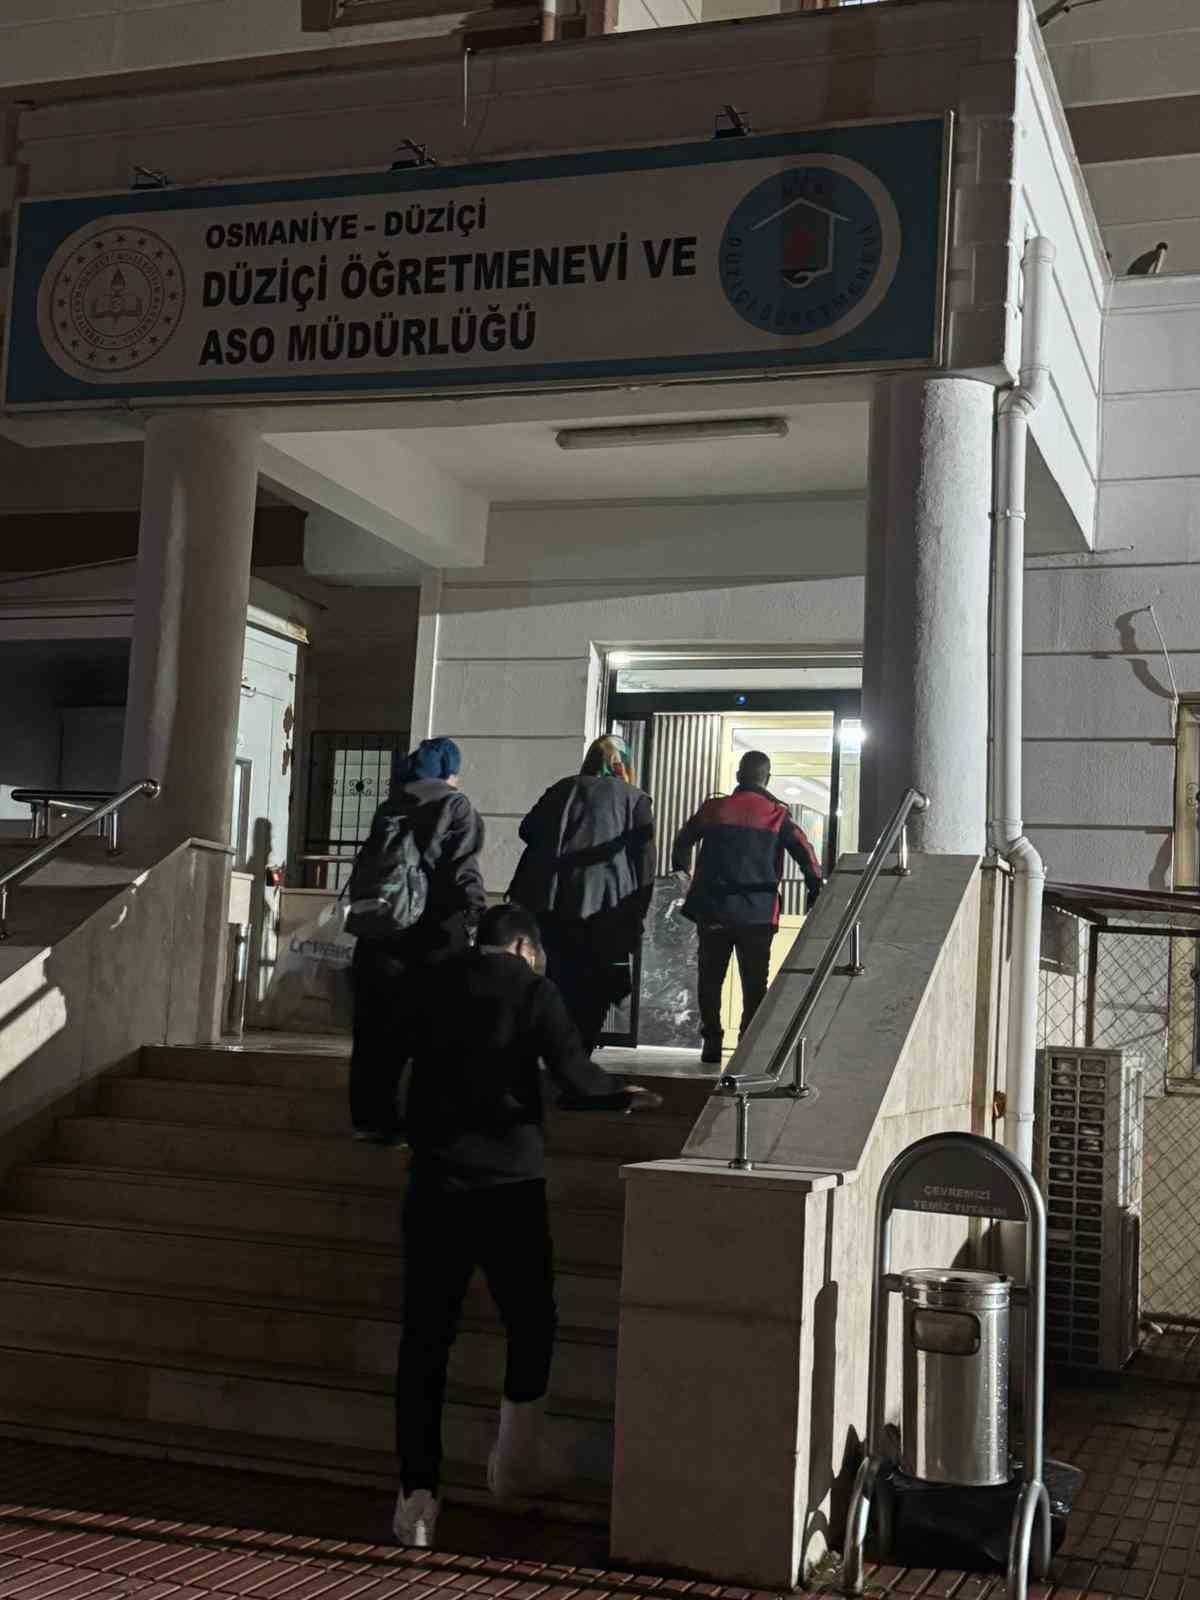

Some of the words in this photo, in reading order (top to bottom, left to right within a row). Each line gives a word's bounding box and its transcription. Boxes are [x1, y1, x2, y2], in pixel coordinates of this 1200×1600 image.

[206, 210, 358, 250] OSMANİYE
[384, 197, 487, 238] DÜZİÇİ
[203, 255, 328, 311] DÜZİÇİ
[341, 232, 628, 300] ÖĞRETMENEVİ
[641, 235, 697, 278] VE
[199, 326, 275, 366] ASO
[287, 303, 537, 362] MÜDÜRLÜĞÜ
